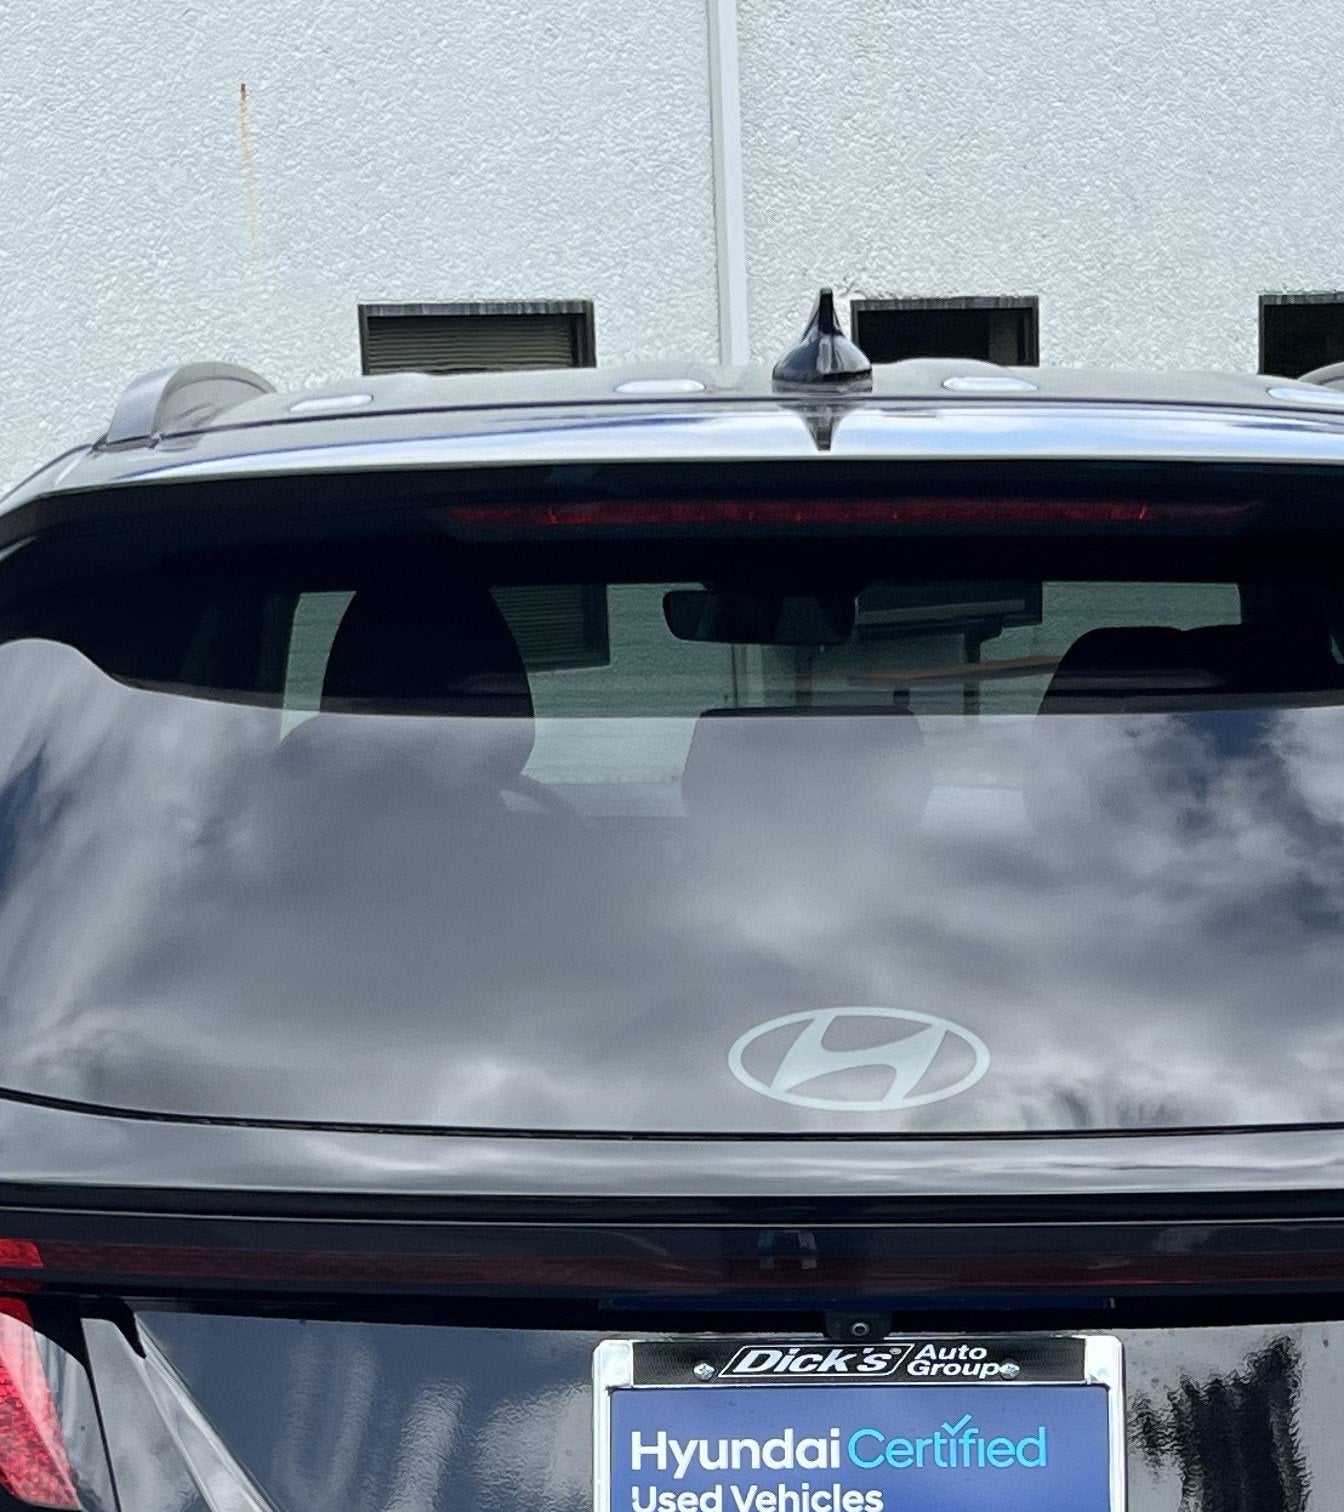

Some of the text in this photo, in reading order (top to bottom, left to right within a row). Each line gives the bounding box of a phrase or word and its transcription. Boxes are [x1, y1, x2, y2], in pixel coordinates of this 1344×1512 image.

[733, 1347, 893, 1373] Dick's
[913, 1343, 988, 1361] Auto
[906, 1359, 1001, 1379] Group
[631, 1417, 1047, 1479] Hyundai Certified
